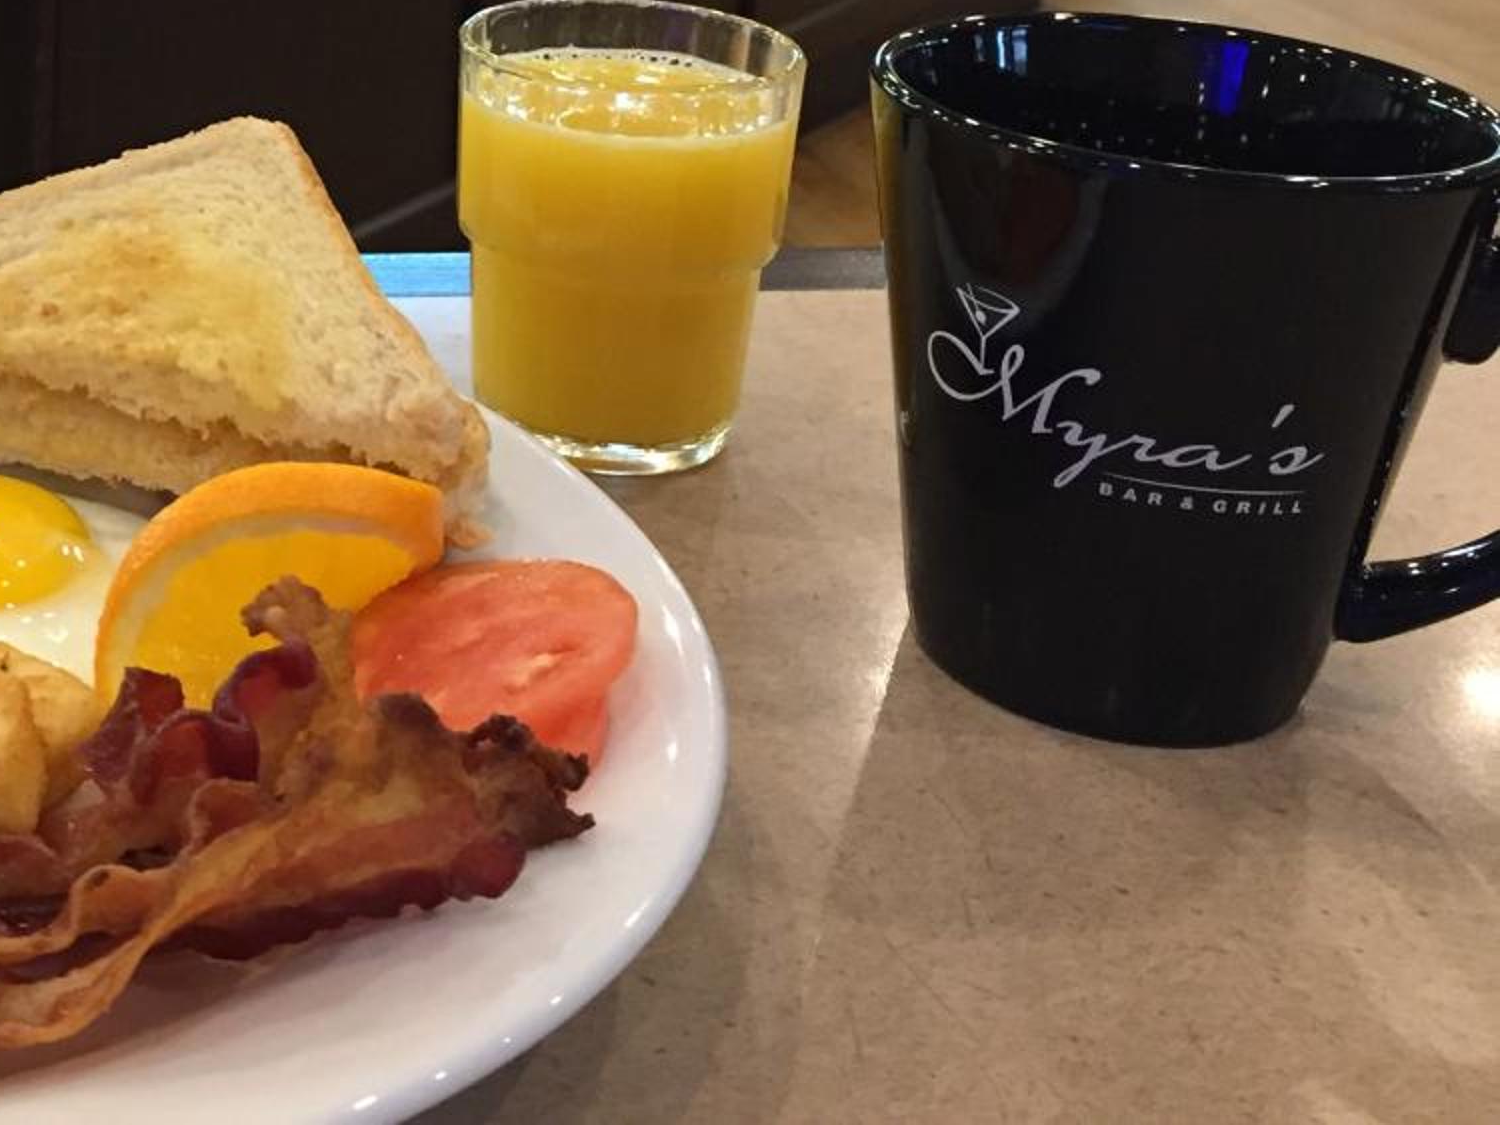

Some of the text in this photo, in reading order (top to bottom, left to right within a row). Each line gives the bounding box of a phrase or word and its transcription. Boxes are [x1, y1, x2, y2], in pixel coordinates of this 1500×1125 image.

[927, 329, 1325, 489] Myra's
[1098, 481, 1303, 515] BAR & GRILL
